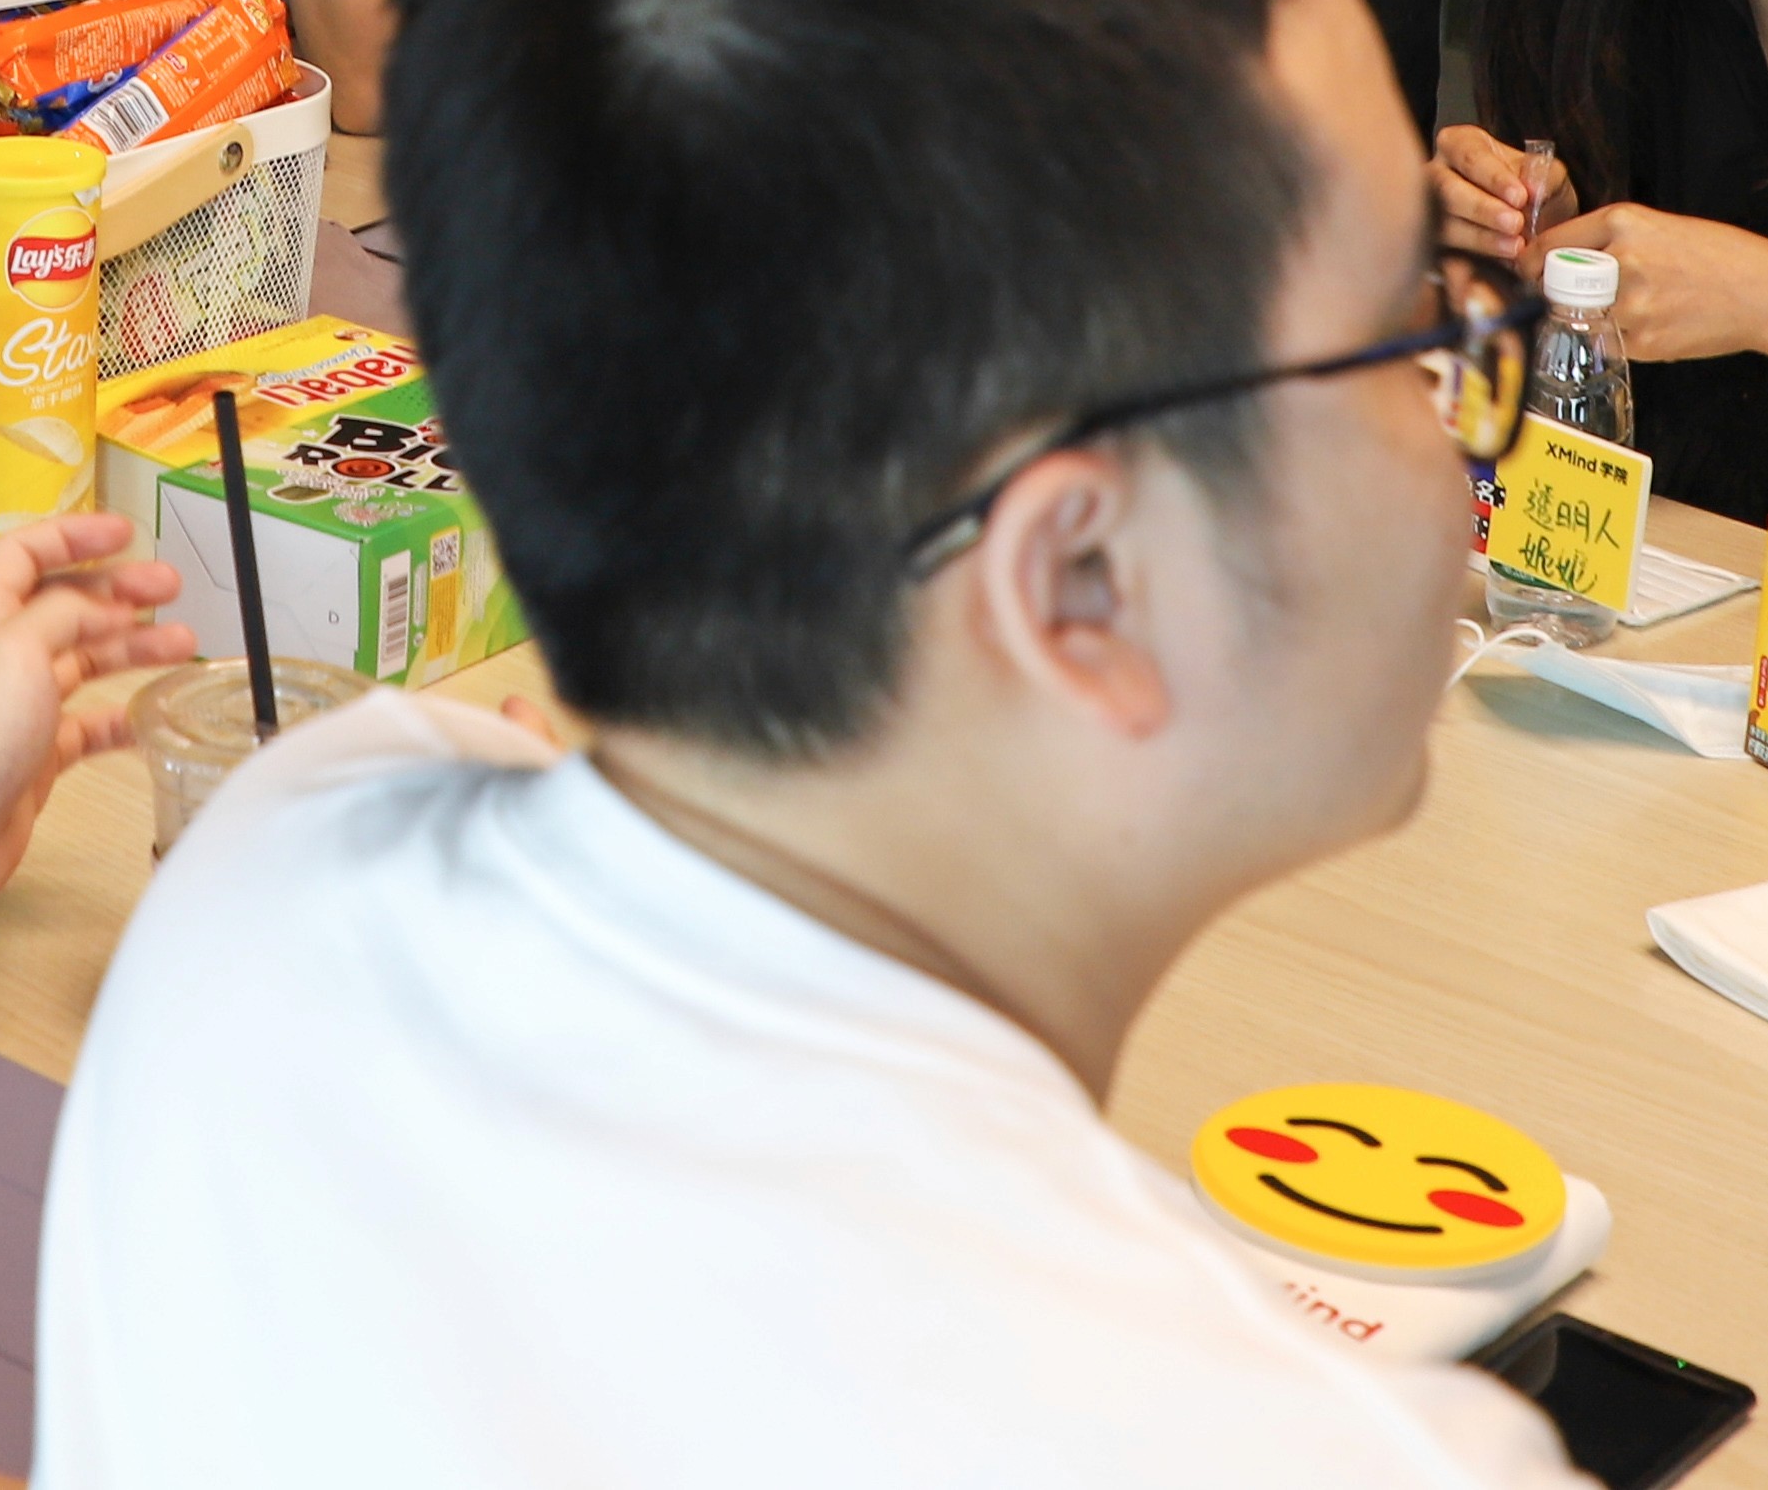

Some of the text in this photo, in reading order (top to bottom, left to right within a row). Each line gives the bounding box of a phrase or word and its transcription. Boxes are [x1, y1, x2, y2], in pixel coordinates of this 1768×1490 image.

[11, 243, 65, 279] Lay's
[1546, 440, 1629, 486] XMind 学院
[1523, 477, 1620, 550] 透明人
